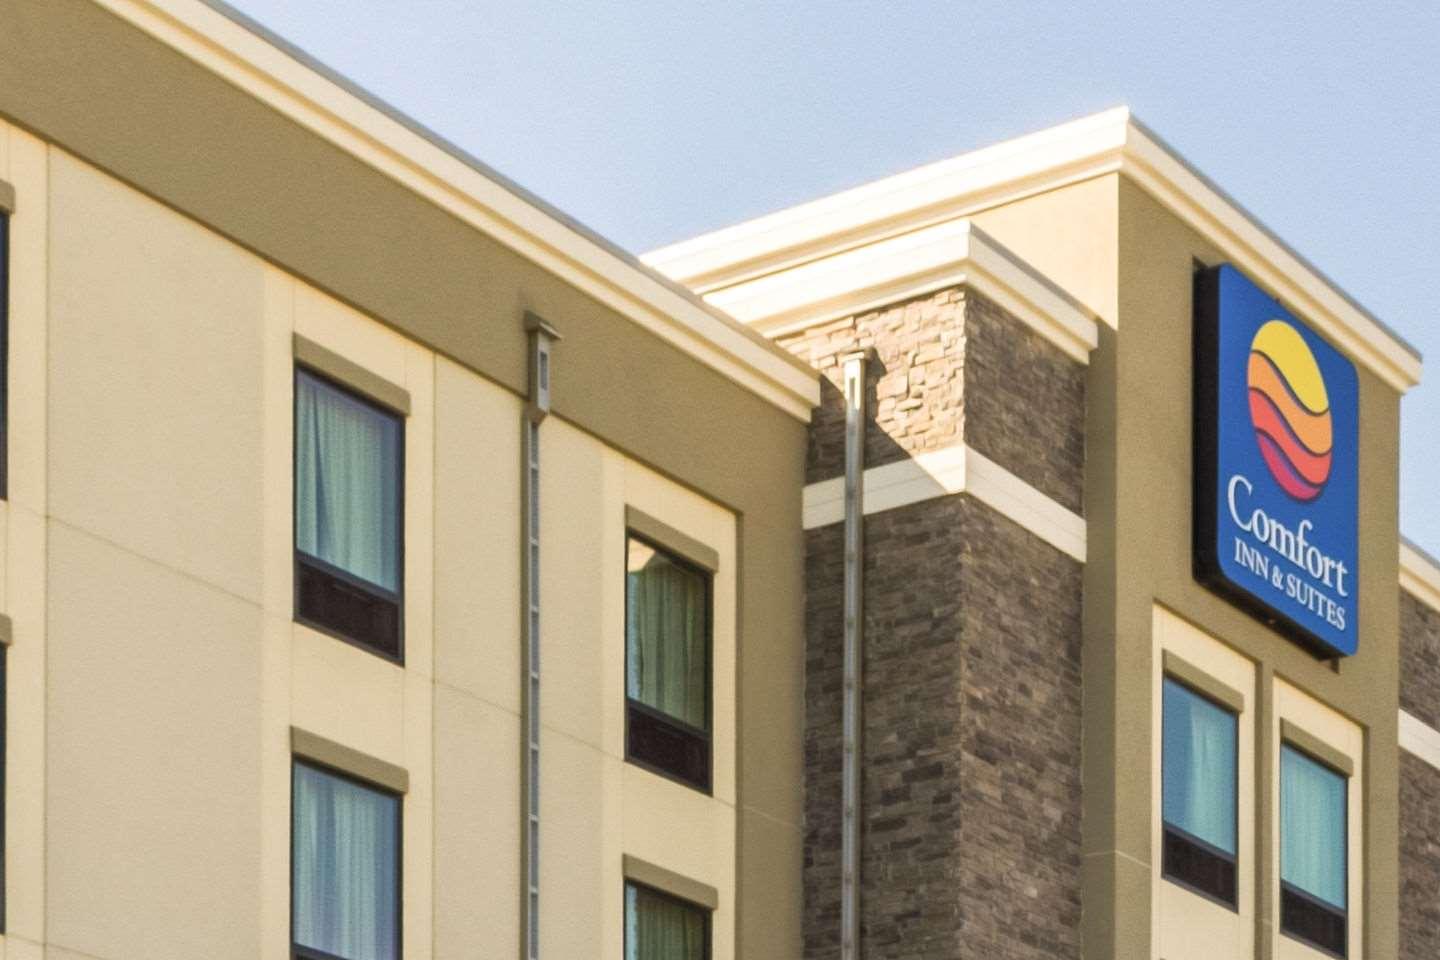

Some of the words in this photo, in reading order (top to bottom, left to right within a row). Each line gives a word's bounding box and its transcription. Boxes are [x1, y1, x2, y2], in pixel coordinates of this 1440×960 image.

[1227, 474, 1349, 597] Comfort
[1234, 536, 1270, 581] INN
[1272, 564, 1284, 591] &
[1286, 572, 1346, 631] SUITES
